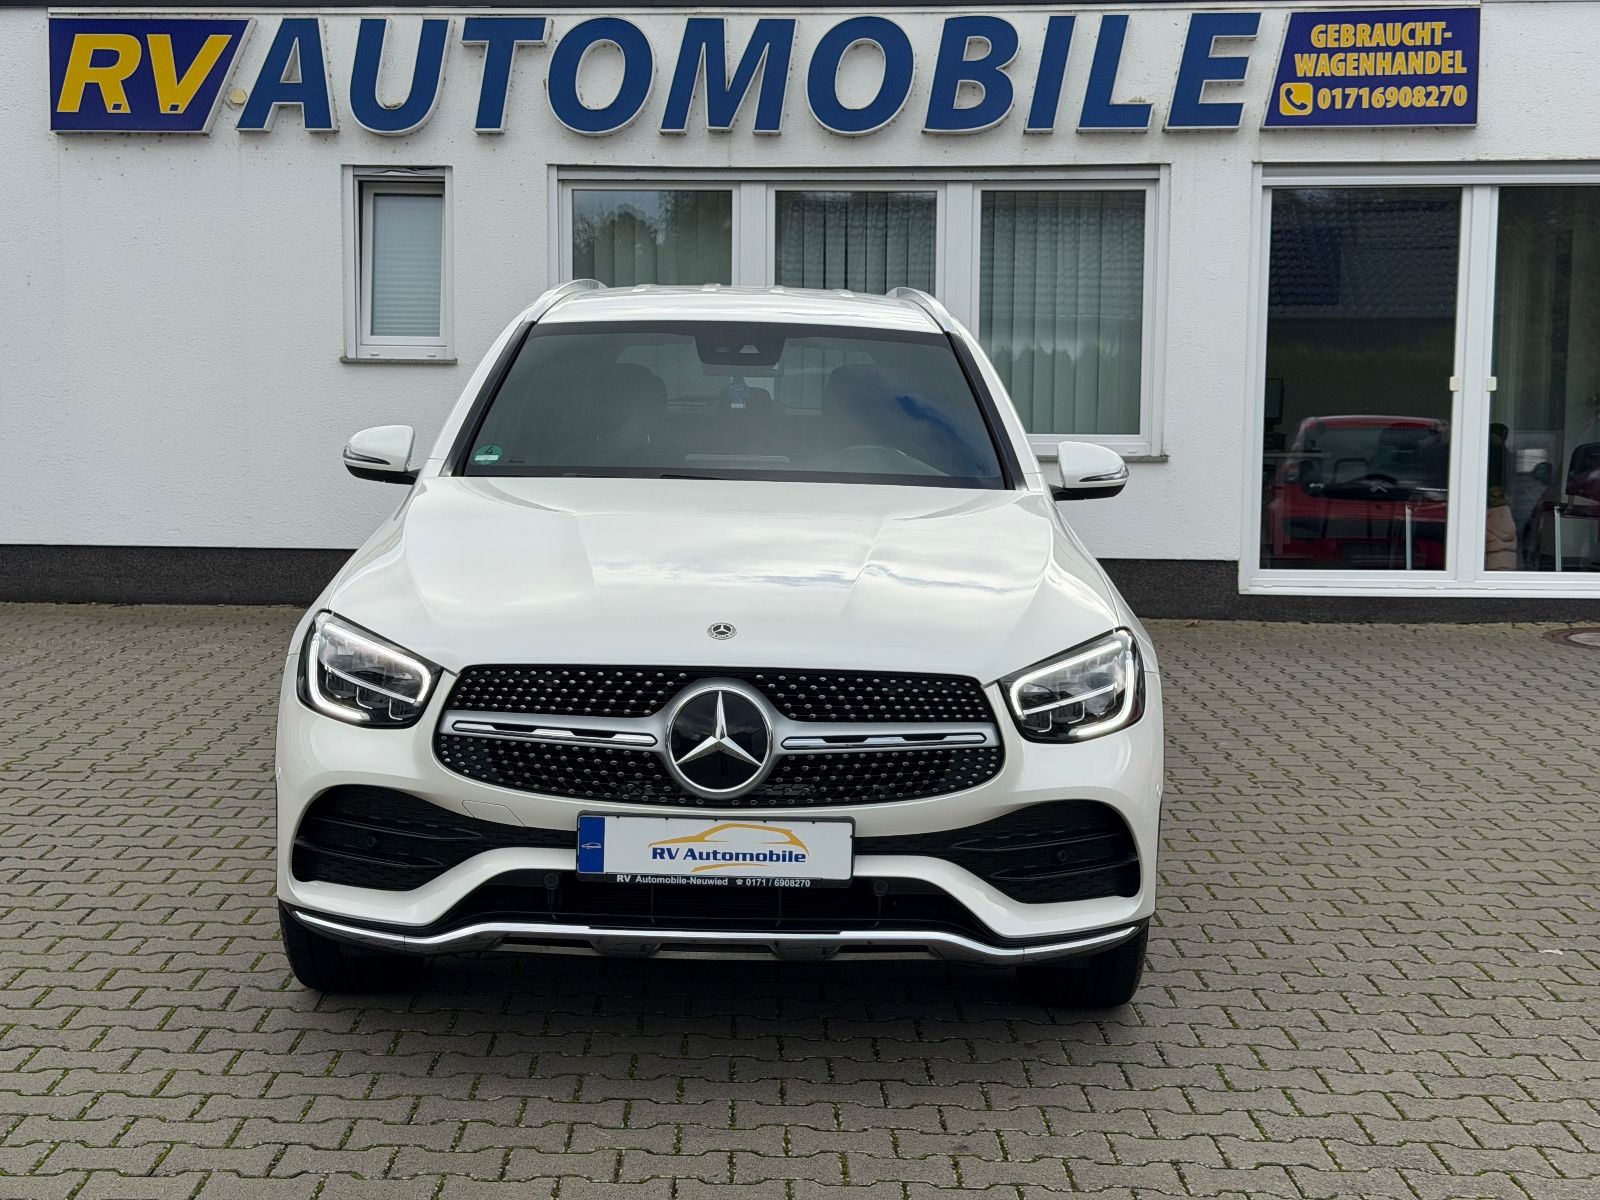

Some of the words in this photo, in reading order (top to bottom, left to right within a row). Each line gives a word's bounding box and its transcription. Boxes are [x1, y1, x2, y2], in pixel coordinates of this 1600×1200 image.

[1310, 21, 1453, 48] GEBRAUCHT-
[235, 12, 1262, 137] AUTOMOBILE
[1294, 50, 1468, 77] WAGENHANDEL
[1317, 84, 1468, 110] 01716908270
[651, 847, 681, 861] RV
[683, 847, 807, 863] Automobile
[616, 874, 632, 883] RV
[635, 875, 728, 886] Automobile-Neuwied
[745, 878, 767, 887] 0171
[774, 878, 811, 888] 6908270
